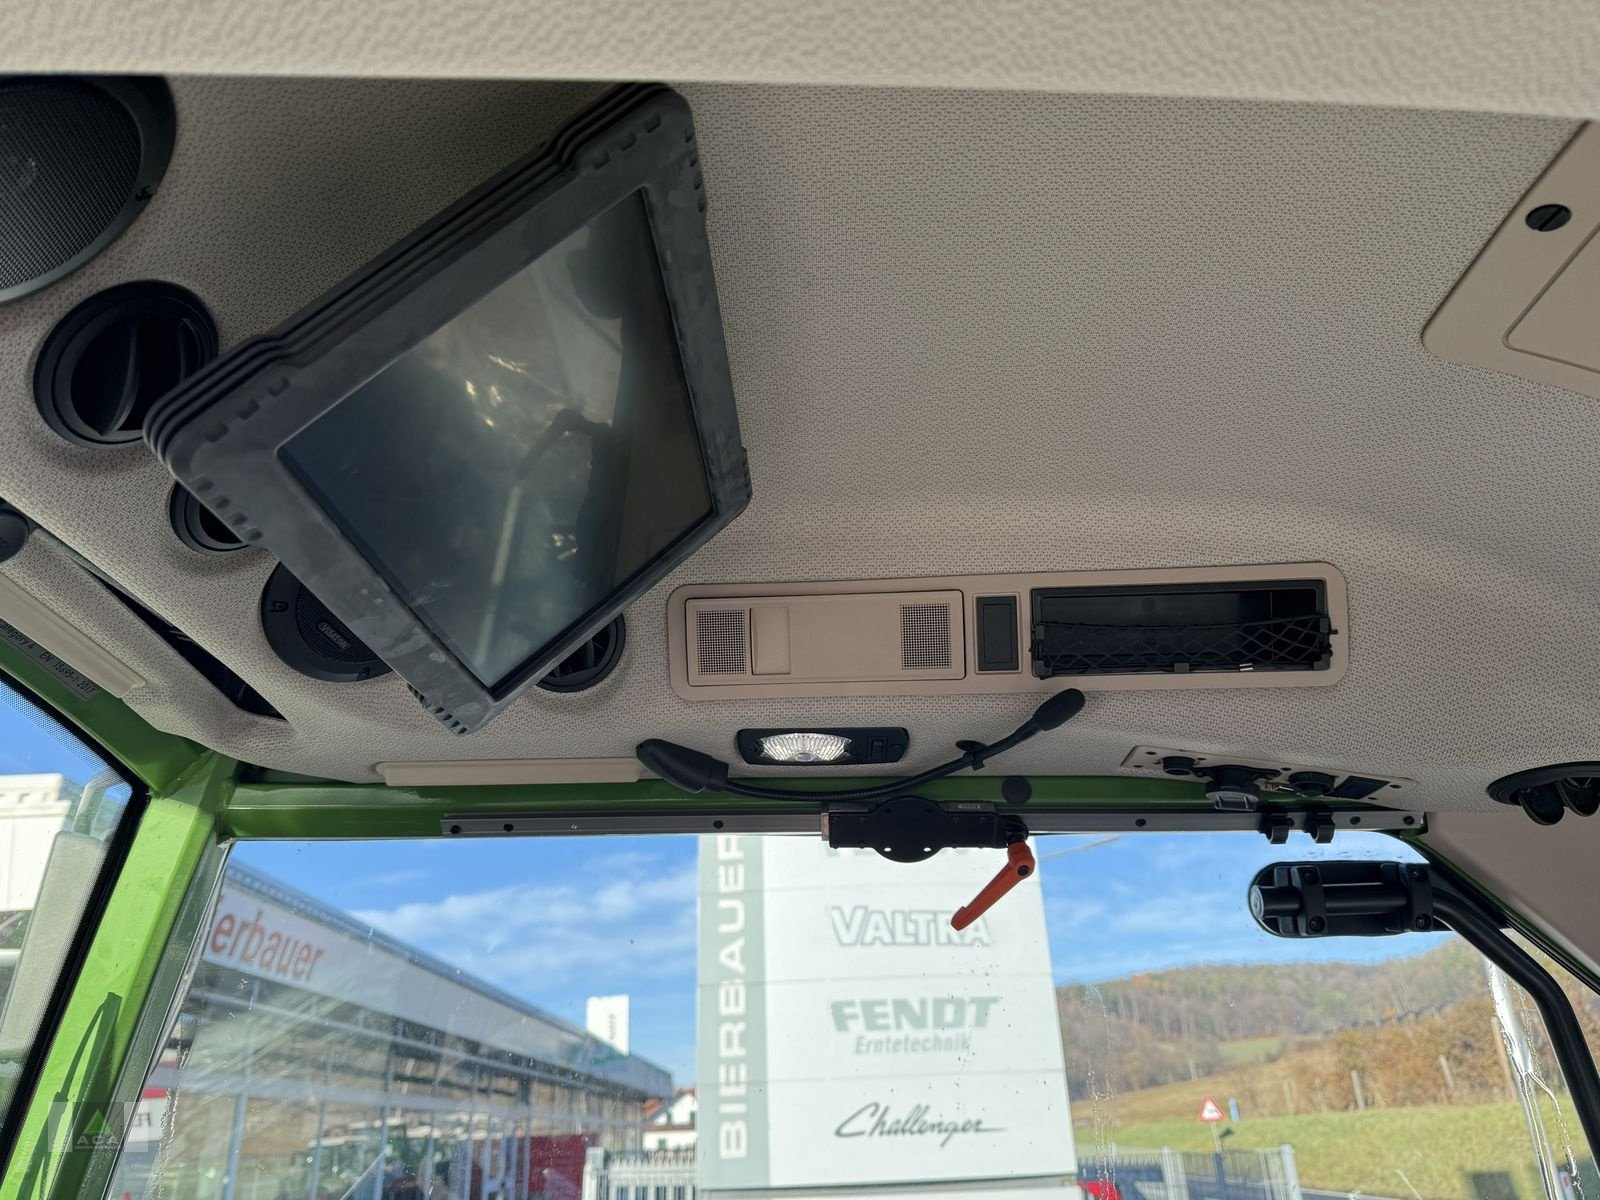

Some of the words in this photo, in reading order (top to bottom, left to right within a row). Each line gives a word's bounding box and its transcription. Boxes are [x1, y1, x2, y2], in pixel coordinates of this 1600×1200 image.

[0, 622, 30, 645] ategory
[39, 651, 54, 662] EN
[212, 898, 325, 981] erbauer
[830, 997, 1000, 1031] FENDT
[854, 1034, 972, 1055] Erntetechnik
[834, 1101, 1009, 1148] Challenger
